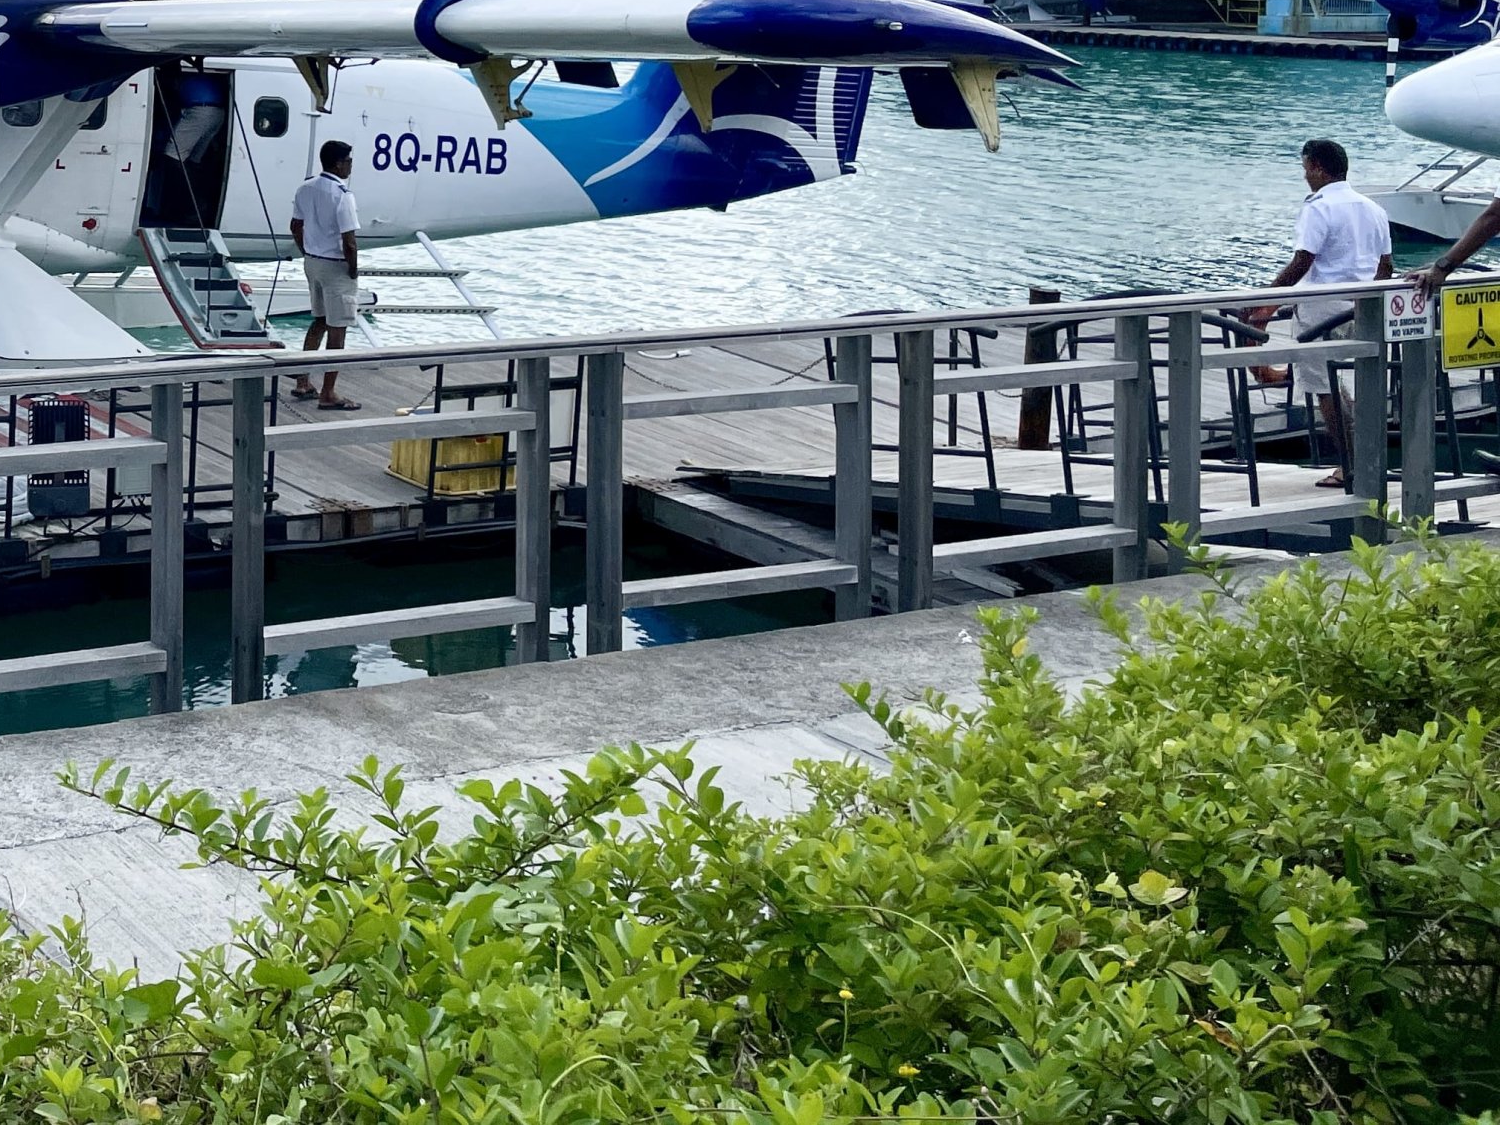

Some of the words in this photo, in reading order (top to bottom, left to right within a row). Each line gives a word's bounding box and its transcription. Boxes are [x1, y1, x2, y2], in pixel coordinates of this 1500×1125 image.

[372, 132, 507, 175] 8Q-RAB
[1400, 317, 1427, 327] SMOKING
[1392, 329, 1400, 337] NO
[1402, 327, 1425, 336] VAPING
[1449, 353, 1478, 363] ROTATING
